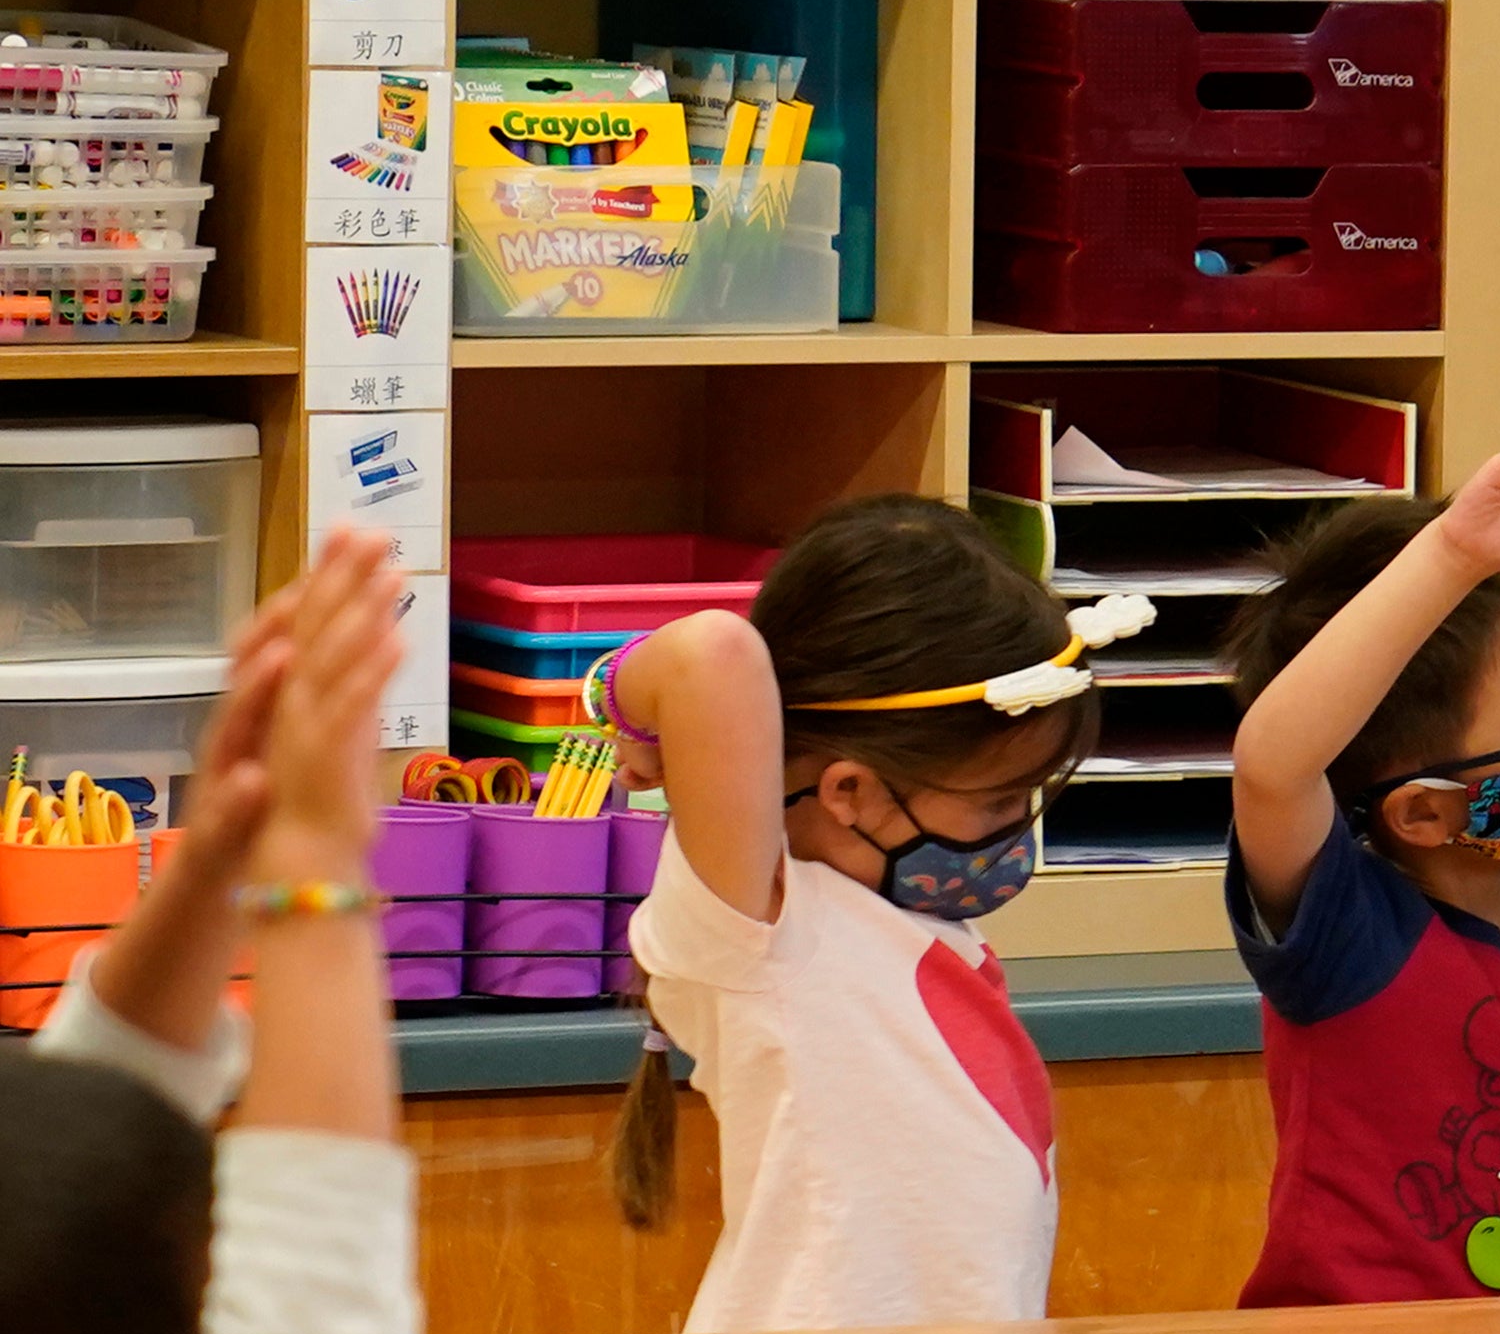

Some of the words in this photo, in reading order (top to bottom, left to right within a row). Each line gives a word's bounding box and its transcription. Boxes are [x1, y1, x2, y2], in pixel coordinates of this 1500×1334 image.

[353, 31, 403, 60] 剪刀
[466, 81, 503, 93] Classic
[1359, 72, 1413, 87] america
[502, 110, 633, 140] Crayola
[335, 208, 420, 238] 彩色筆
[1365, 235, 1418, 251] america
[618, 246, 689, 268] Alaska
[574, 276, 599, 298] 10
[350, 376, 405, 405] 蠟筆
